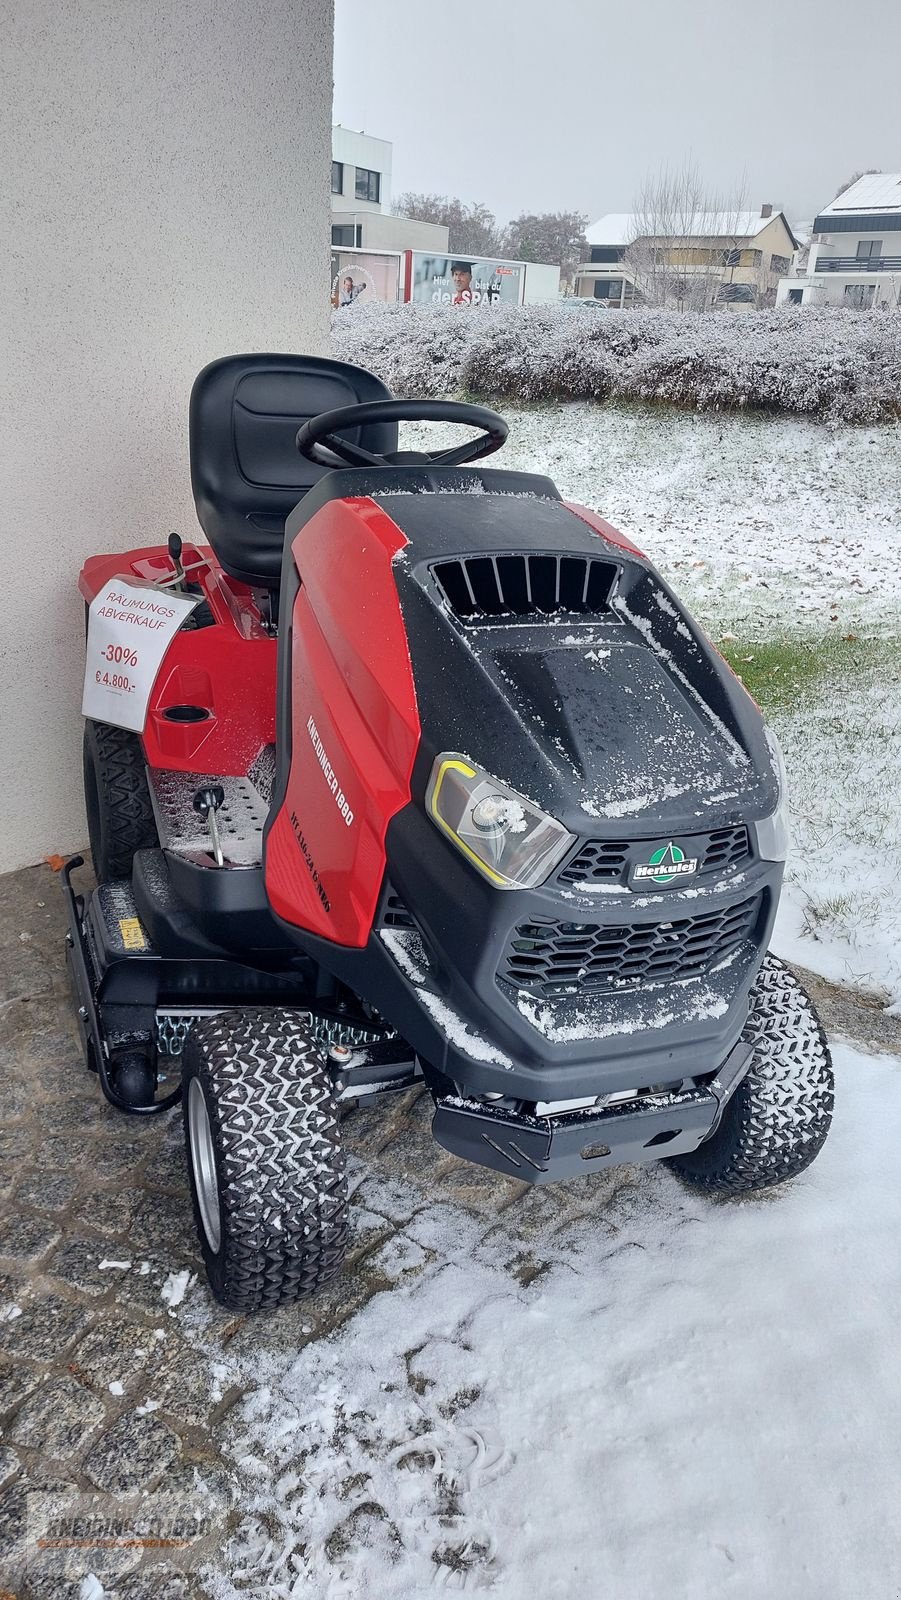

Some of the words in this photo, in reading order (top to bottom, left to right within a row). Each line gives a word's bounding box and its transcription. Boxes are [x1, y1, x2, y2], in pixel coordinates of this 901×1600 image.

[433, 275, 449, 286] Hier
[475, 280, 490, 290] bist
[491, 279, 501, 291] du
[432, 288, 458, 305] der
[461, 290, 501, 306] SPAR
[106, 592, 176, 618] RÄUMUNGS
[97, 606, 167, 631] ABVERKAUF
[101, 644, 138, 667] -30%
[95, 670, 101, 682] €
[103, 672, 136, 692] 4.800,-
[307, 715, 338, 794] KNEIDINGER
[335, 788, 354, 826] 1880
[636, 863, 694, 876] Herkules
